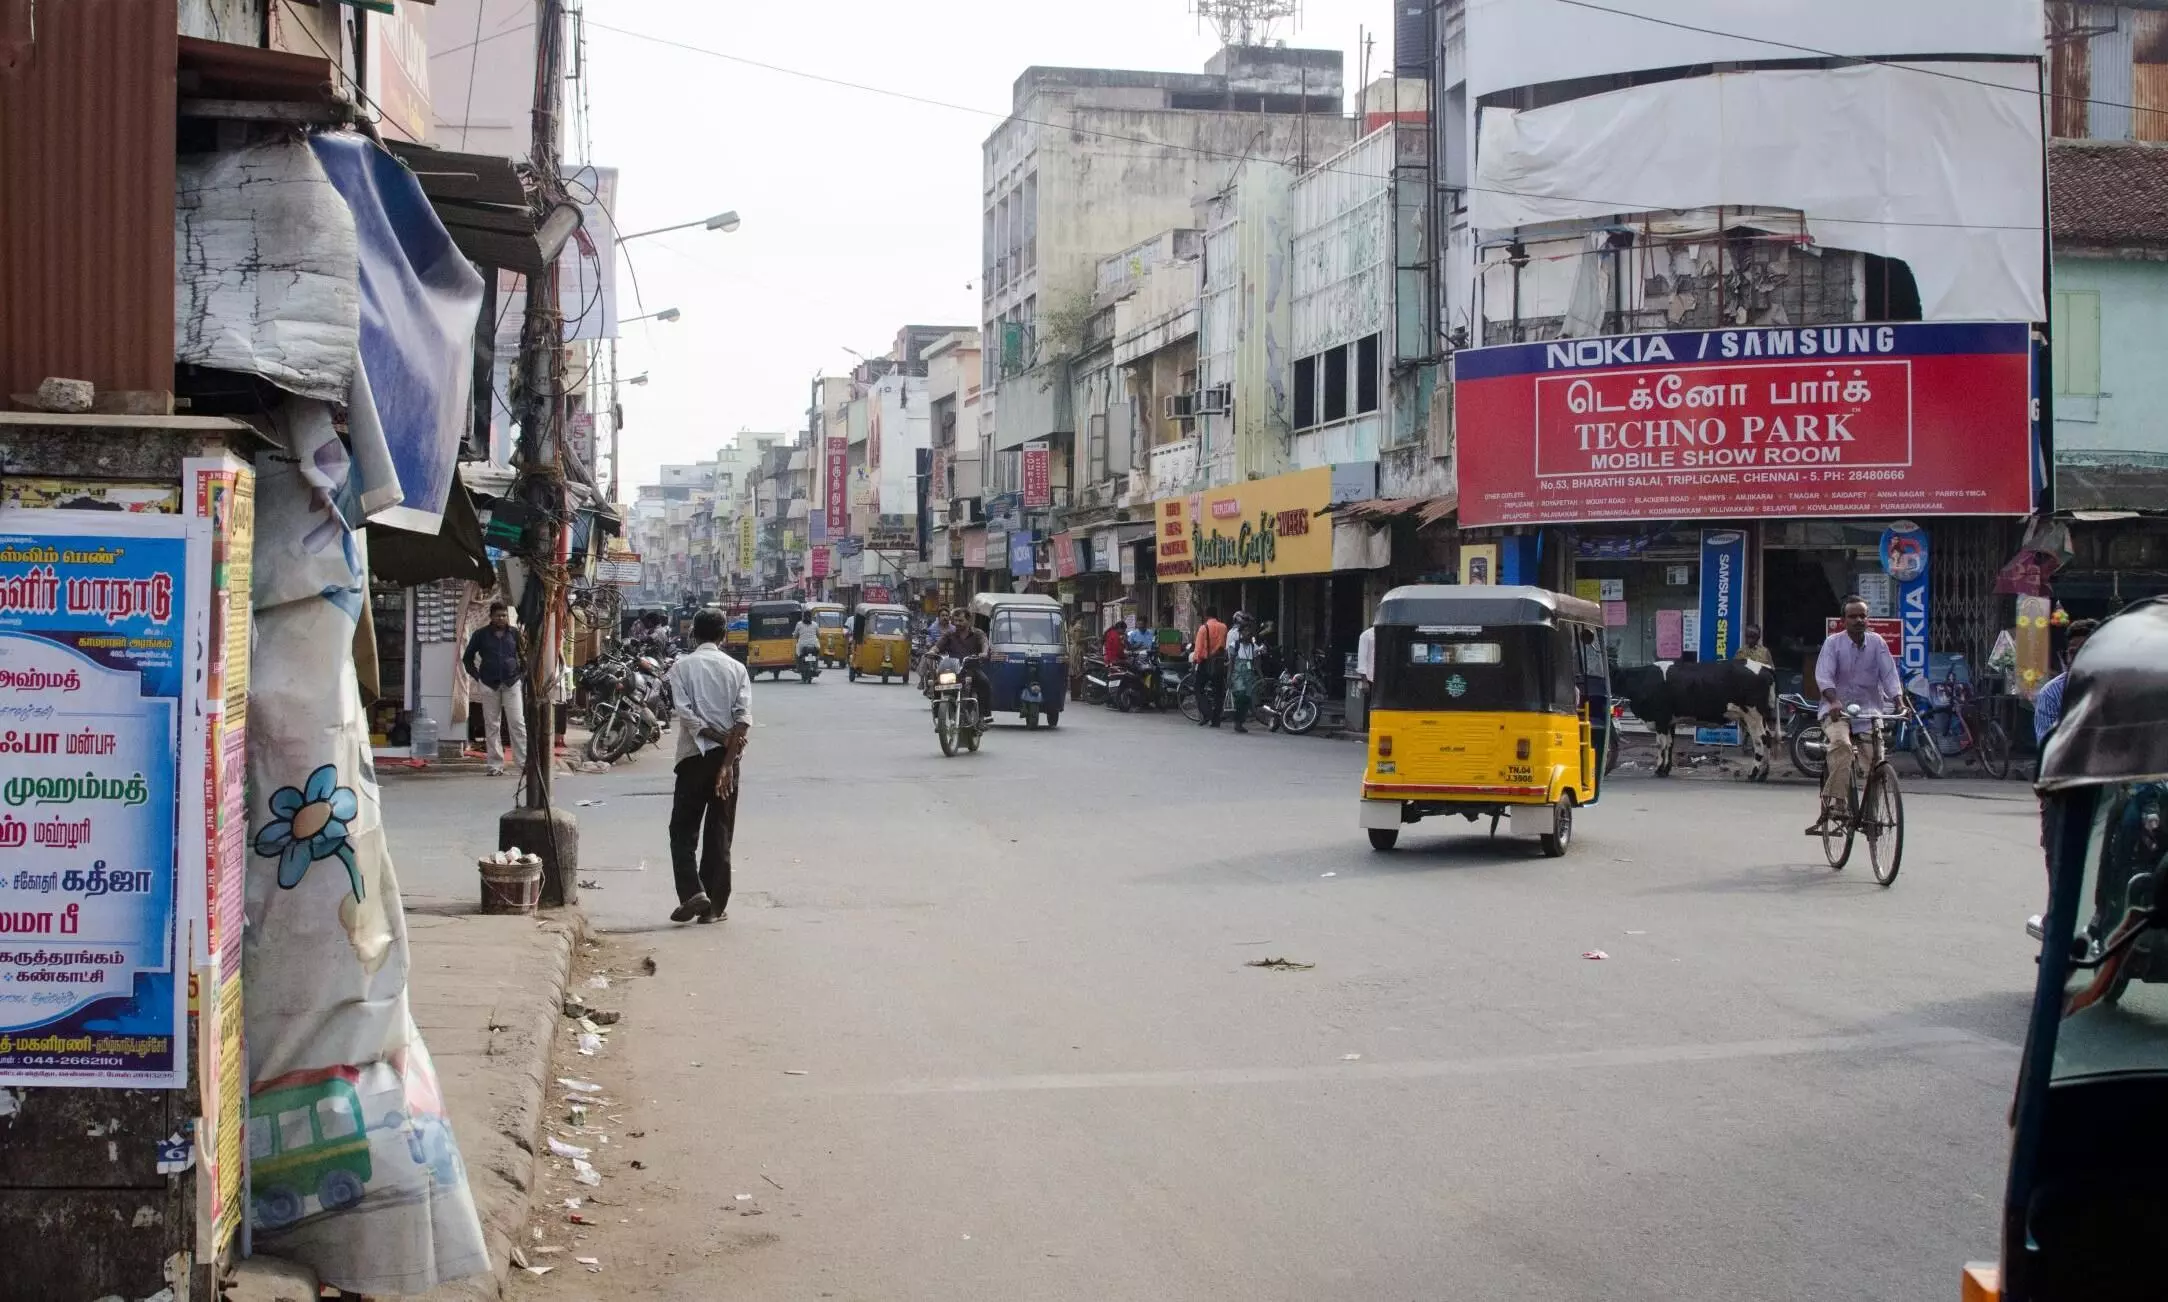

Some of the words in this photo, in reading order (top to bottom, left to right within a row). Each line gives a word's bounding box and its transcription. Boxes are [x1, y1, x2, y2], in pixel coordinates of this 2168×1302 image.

[1546, 336, 1675, 369] NOKIA
[1721, 326, 1895, 357] SAMSUNG
[1567, 374, 1748, 413] டெக்னோ
[1770, 368, 1872, 405] பார்க்
[1574, 418, 1727, 451] TECHNO
[1741, 413, 1856, 446] PARK
[1591, 449, 1675, 471] MOBILE
[1682, 447, 1757, 468] SHOW
[1764, 446, 1841, 464] ROOM
[1572, 477, 1625, 488] BHARATHI
[1627, 476, 1664, 487] SALAI,
[1667, 474, 1740, 486] TRIPLICANE,
[1743, 472, 1800, 483] CHENNAI
[1824, 471, 1845, 481] PH:
[1848, 470, 1905, 481] 28480666
[66, 571, 175, 623] மாநாடு
[1718, 553, 1730, 617] SAMSUNG
[4, 771, 148, 808] முஹம்மத்
[13, 870, 58, 894] சகோதரி
[62, 859, 152, 899] கதீஜா
[60, 903, 80, 934] பீ
[16, 967, 104, 983] கண்காட்சி
